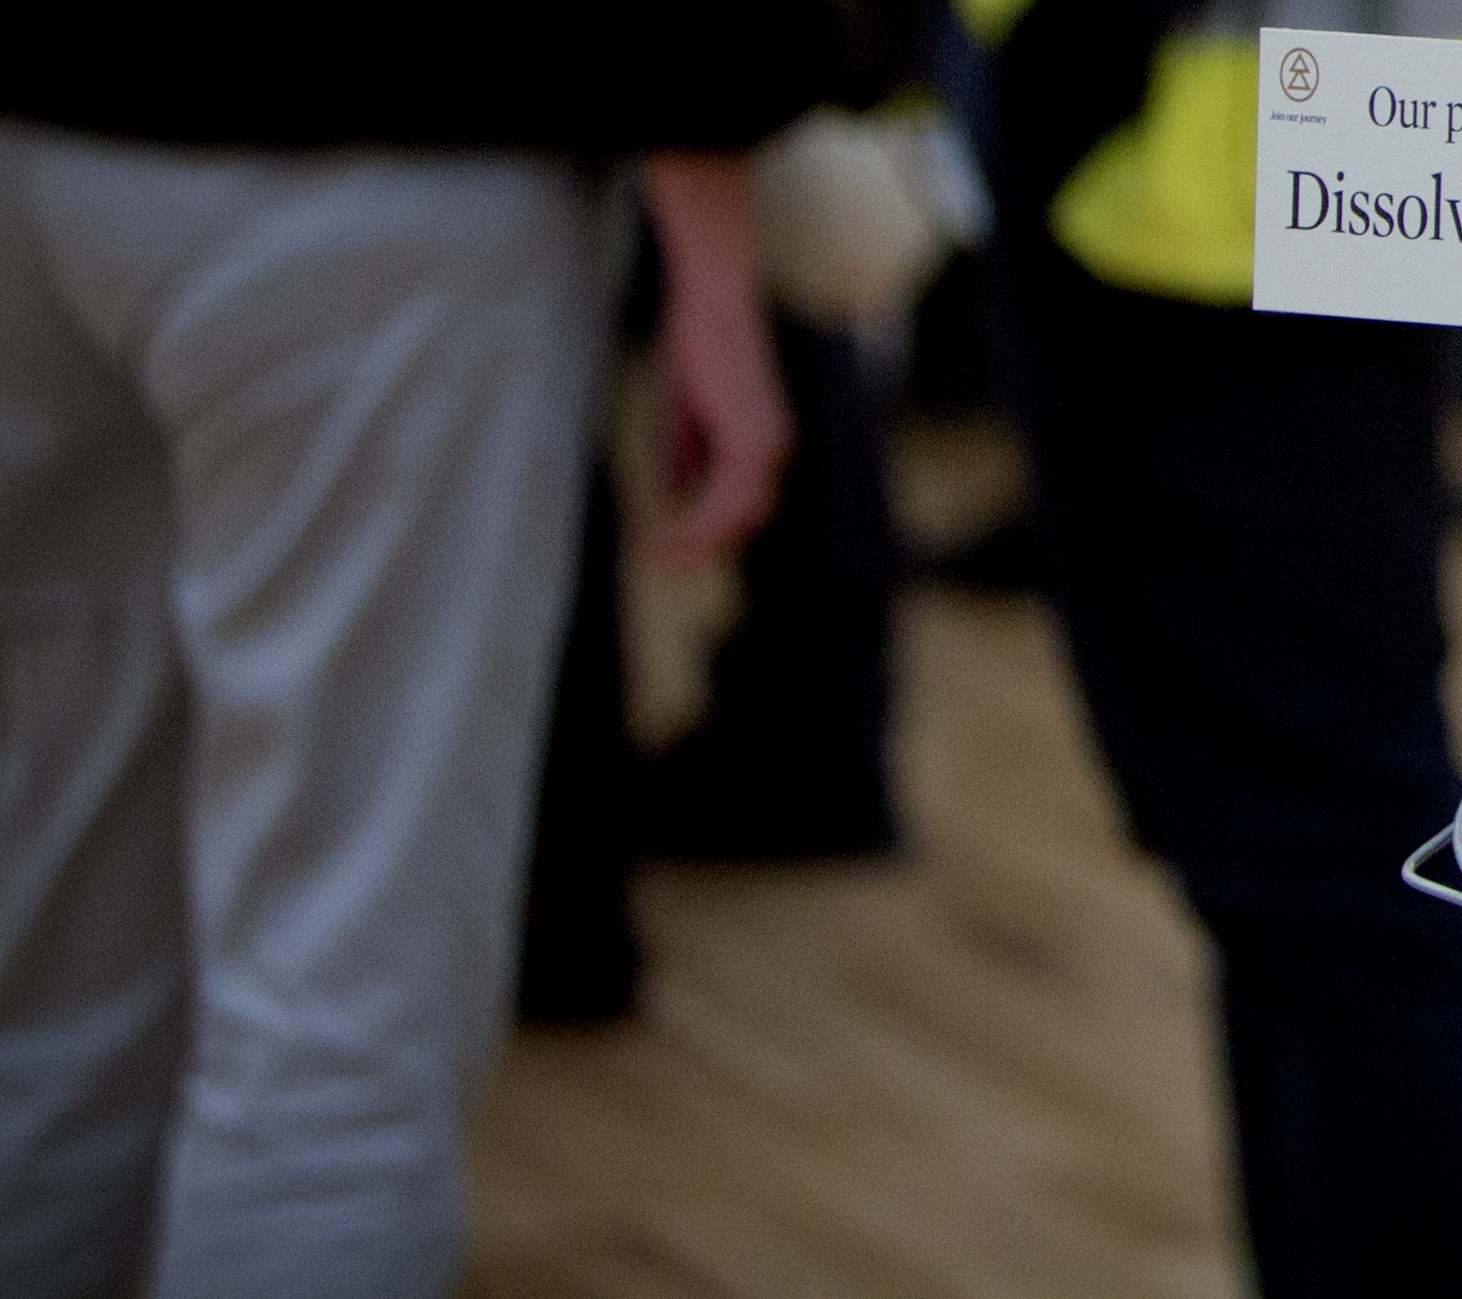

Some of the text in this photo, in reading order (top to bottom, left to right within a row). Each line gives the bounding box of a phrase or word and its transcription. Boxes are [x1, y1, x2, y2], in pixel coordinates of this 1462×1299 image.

[1270, 111, 1285, 121] Join
[1299, 113, 1328, 126] journey
[1368, 86, 1438, 130] Our
